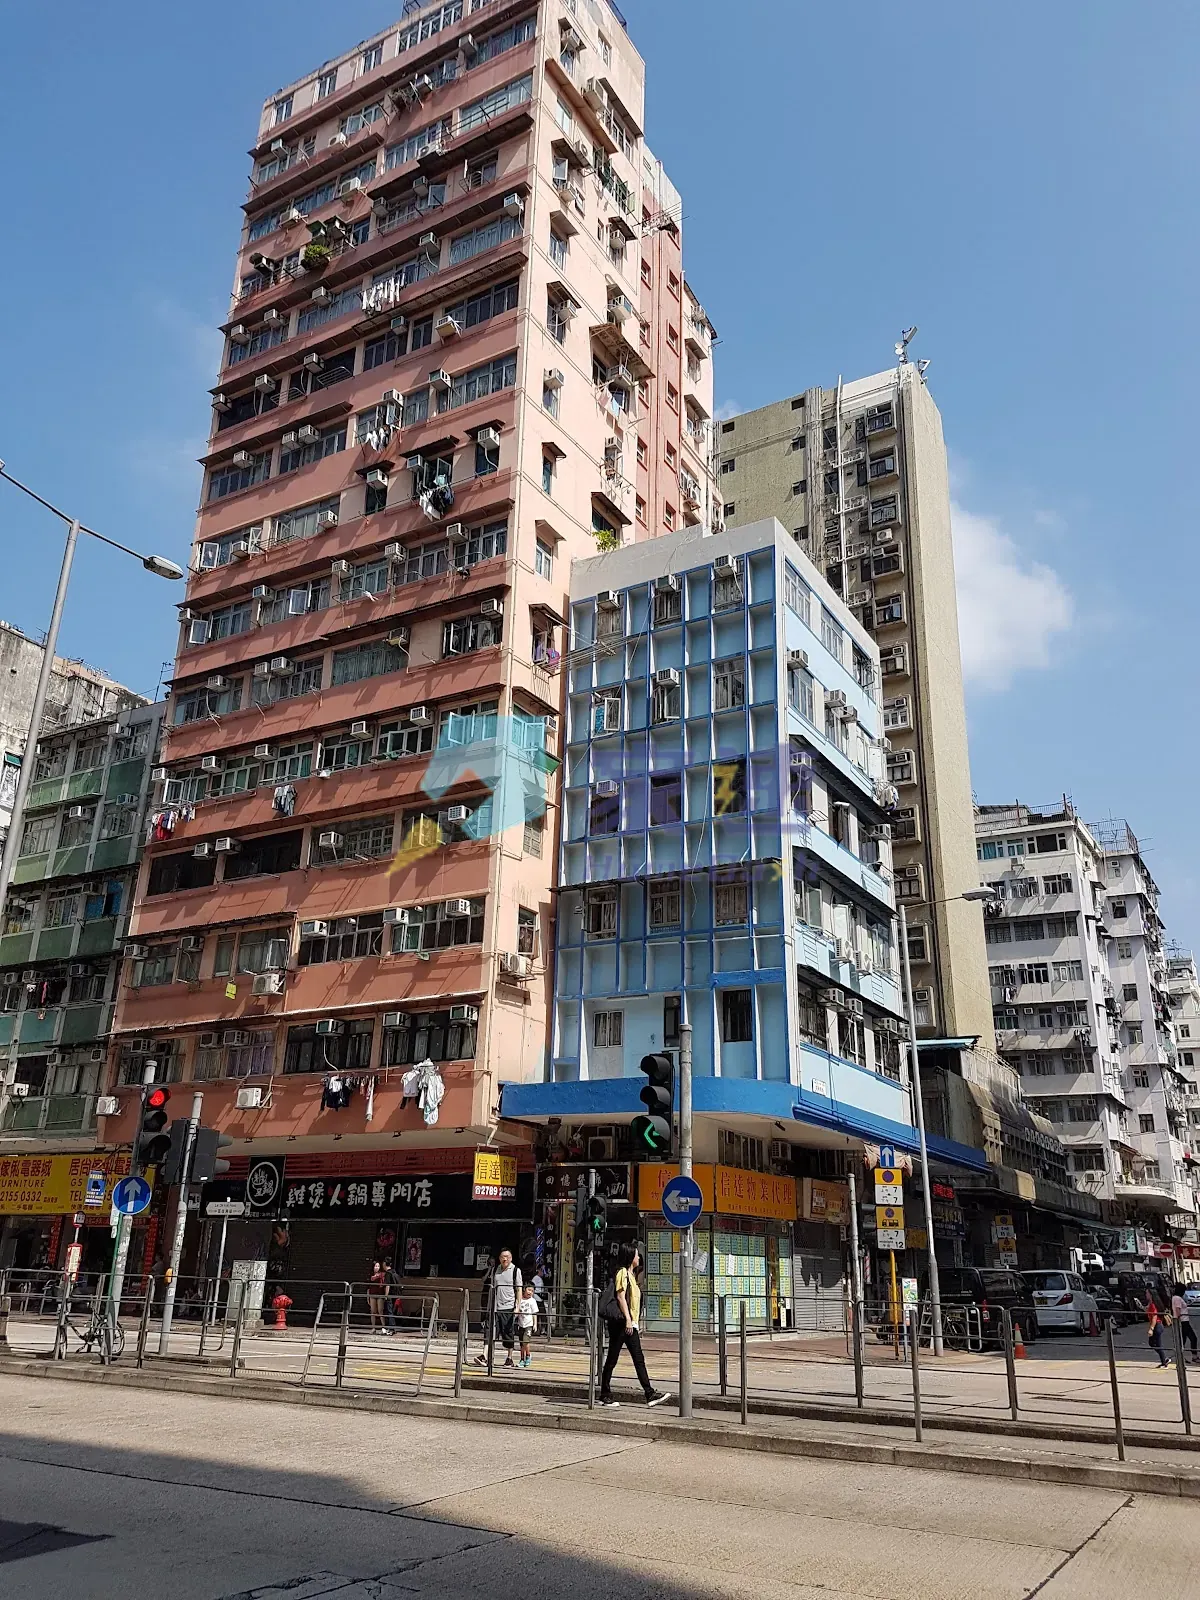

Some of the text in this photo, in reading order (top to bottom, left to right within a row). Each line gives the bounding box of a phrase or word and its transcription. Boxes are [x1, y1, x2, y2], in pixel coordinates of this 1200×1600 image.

[477, 1159, 501, 1180] 信達
[70, 1178, 83, 1187] GS
[721, 1171, 792, 1205] 信達物業代理
[0, 1191, 19, 1202] 2155
[20, 1190, 42, 1202] 0332
[481, 1186, 498, 1196] 2789
[895, 1241, 904, 1249] 12
